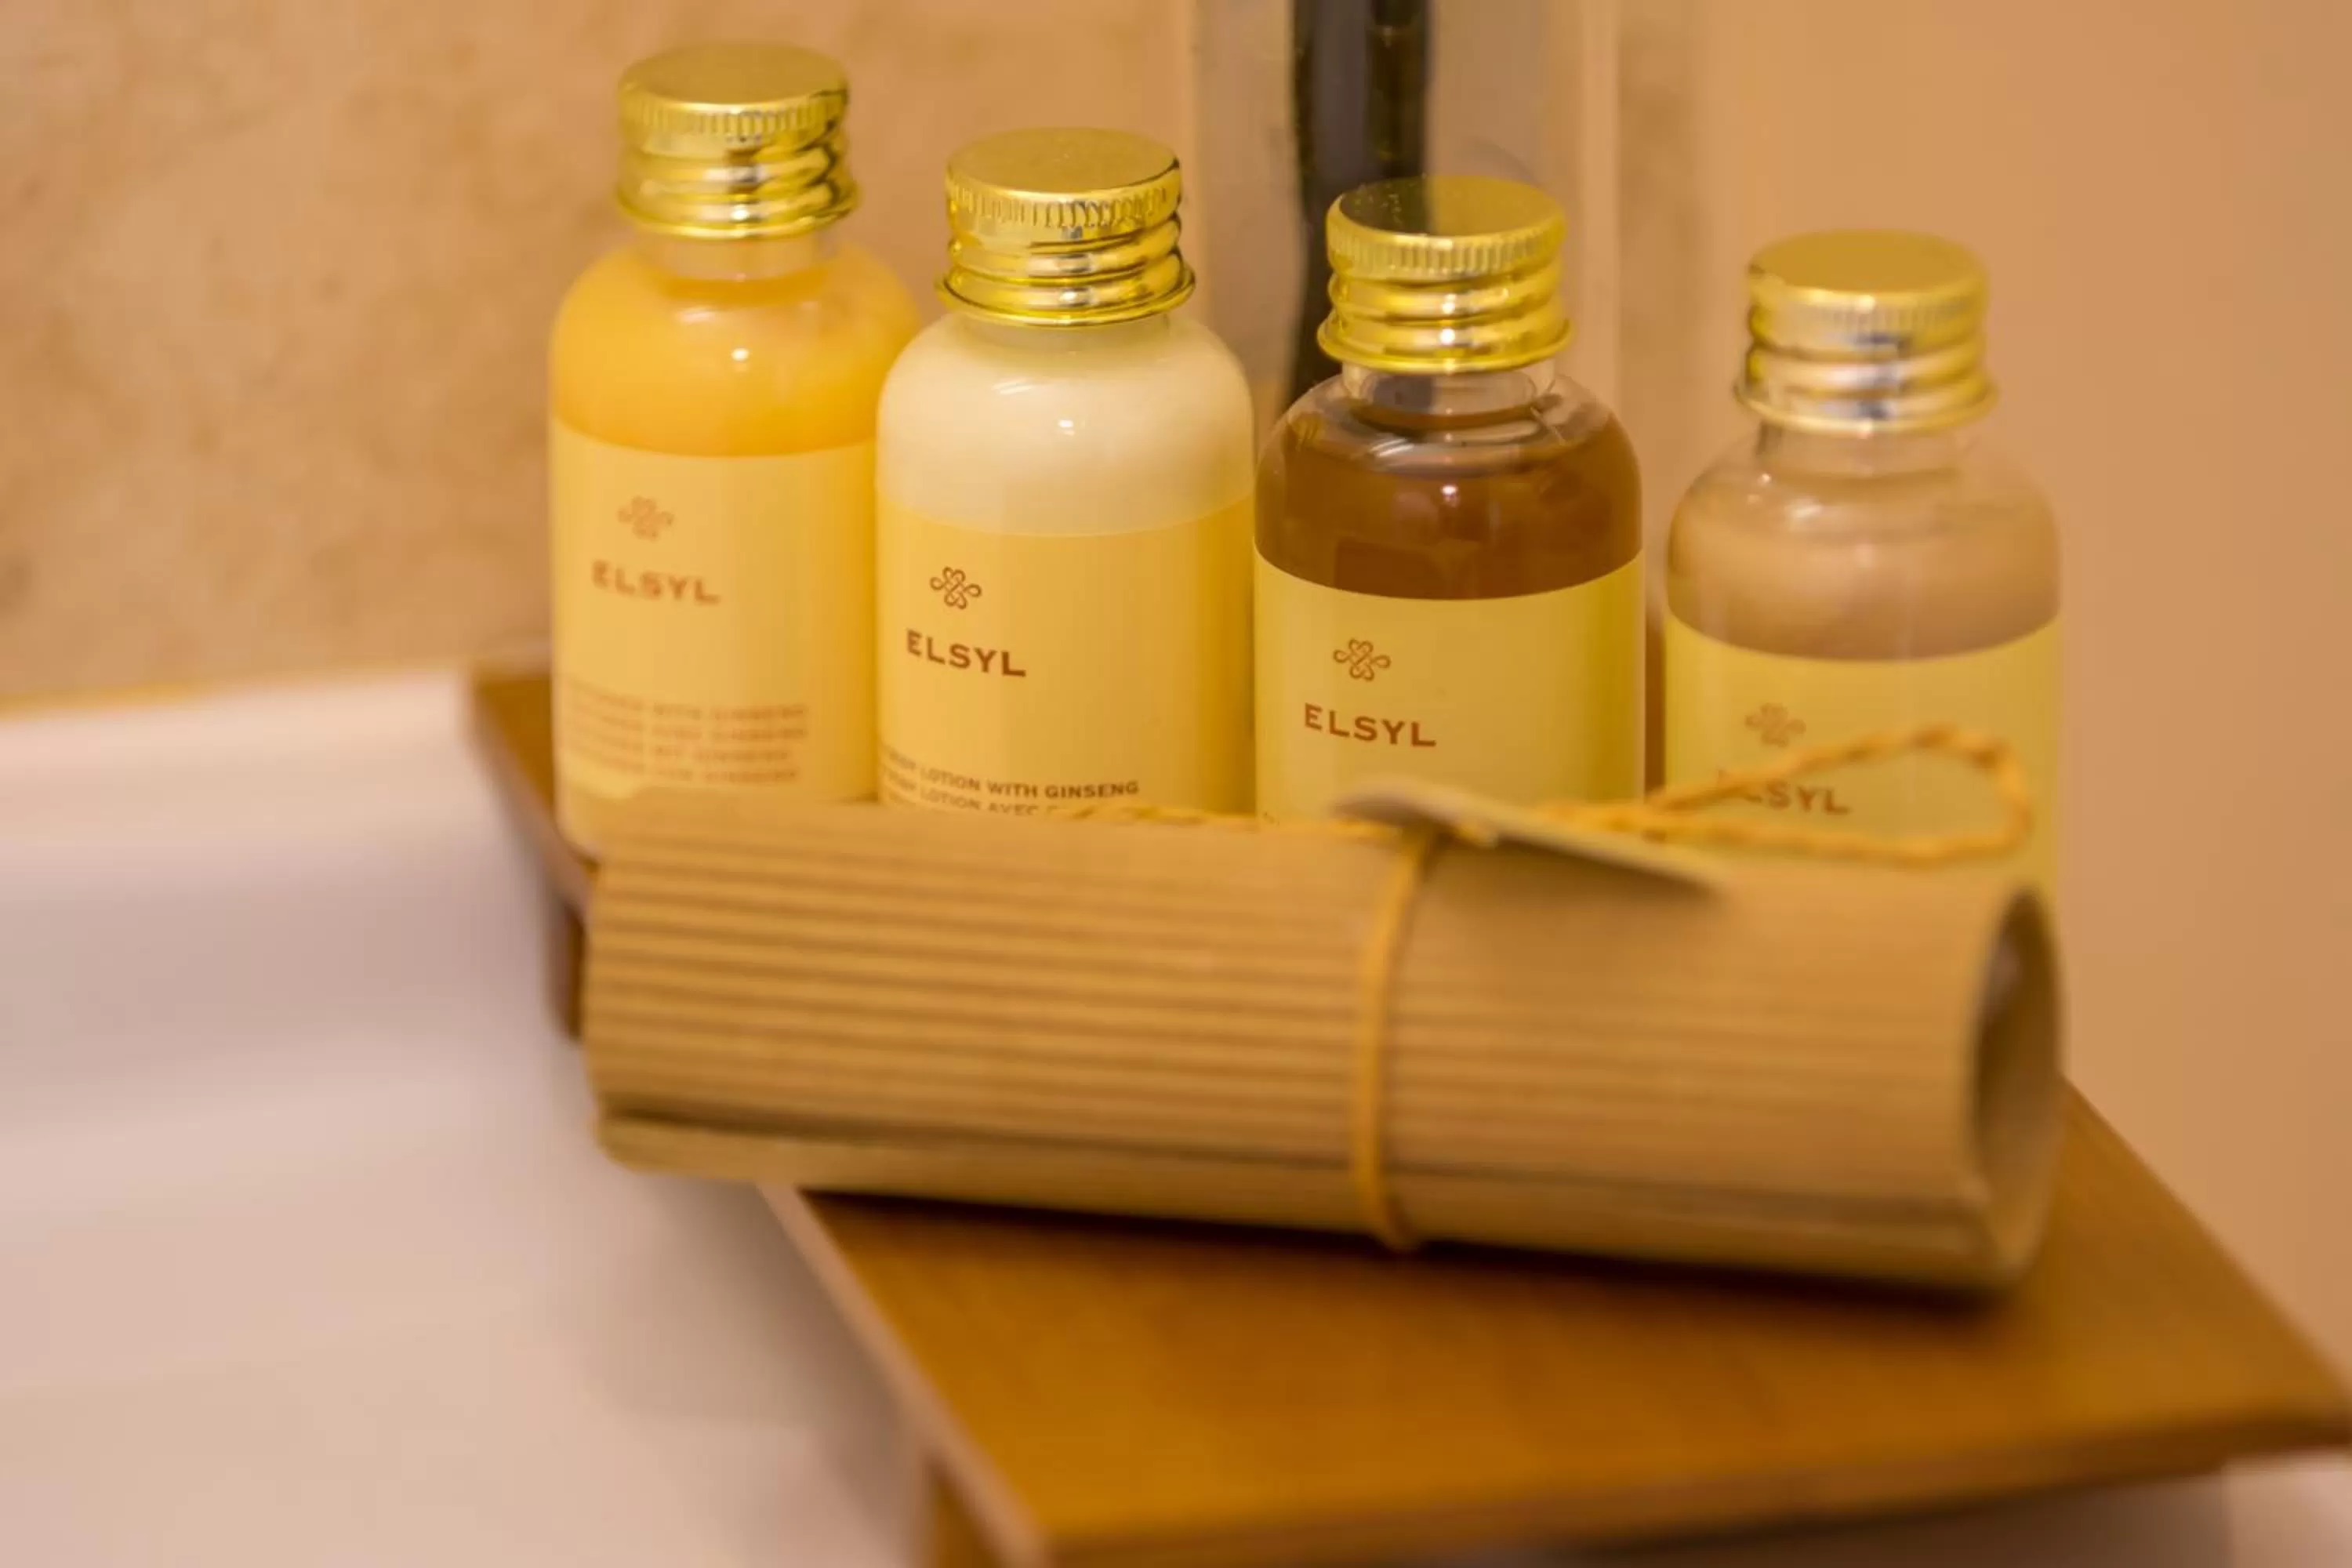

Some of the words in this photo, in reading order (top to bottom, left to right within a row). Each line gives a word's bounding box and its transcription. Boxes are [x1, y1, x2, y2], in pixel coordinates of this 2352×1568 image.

[592, 559, 720, 605] ELSYL
[906, 629, 1026, 677] ELSYL
[1304, 702, 1437, 747] ELSYL
[920, 767, 980, 791] LOTION
[986, 779, 1038, 798] WITH
[1044, 779, 1140, 800] GINSENG
[1717, 768, 1850, 815] SYL
